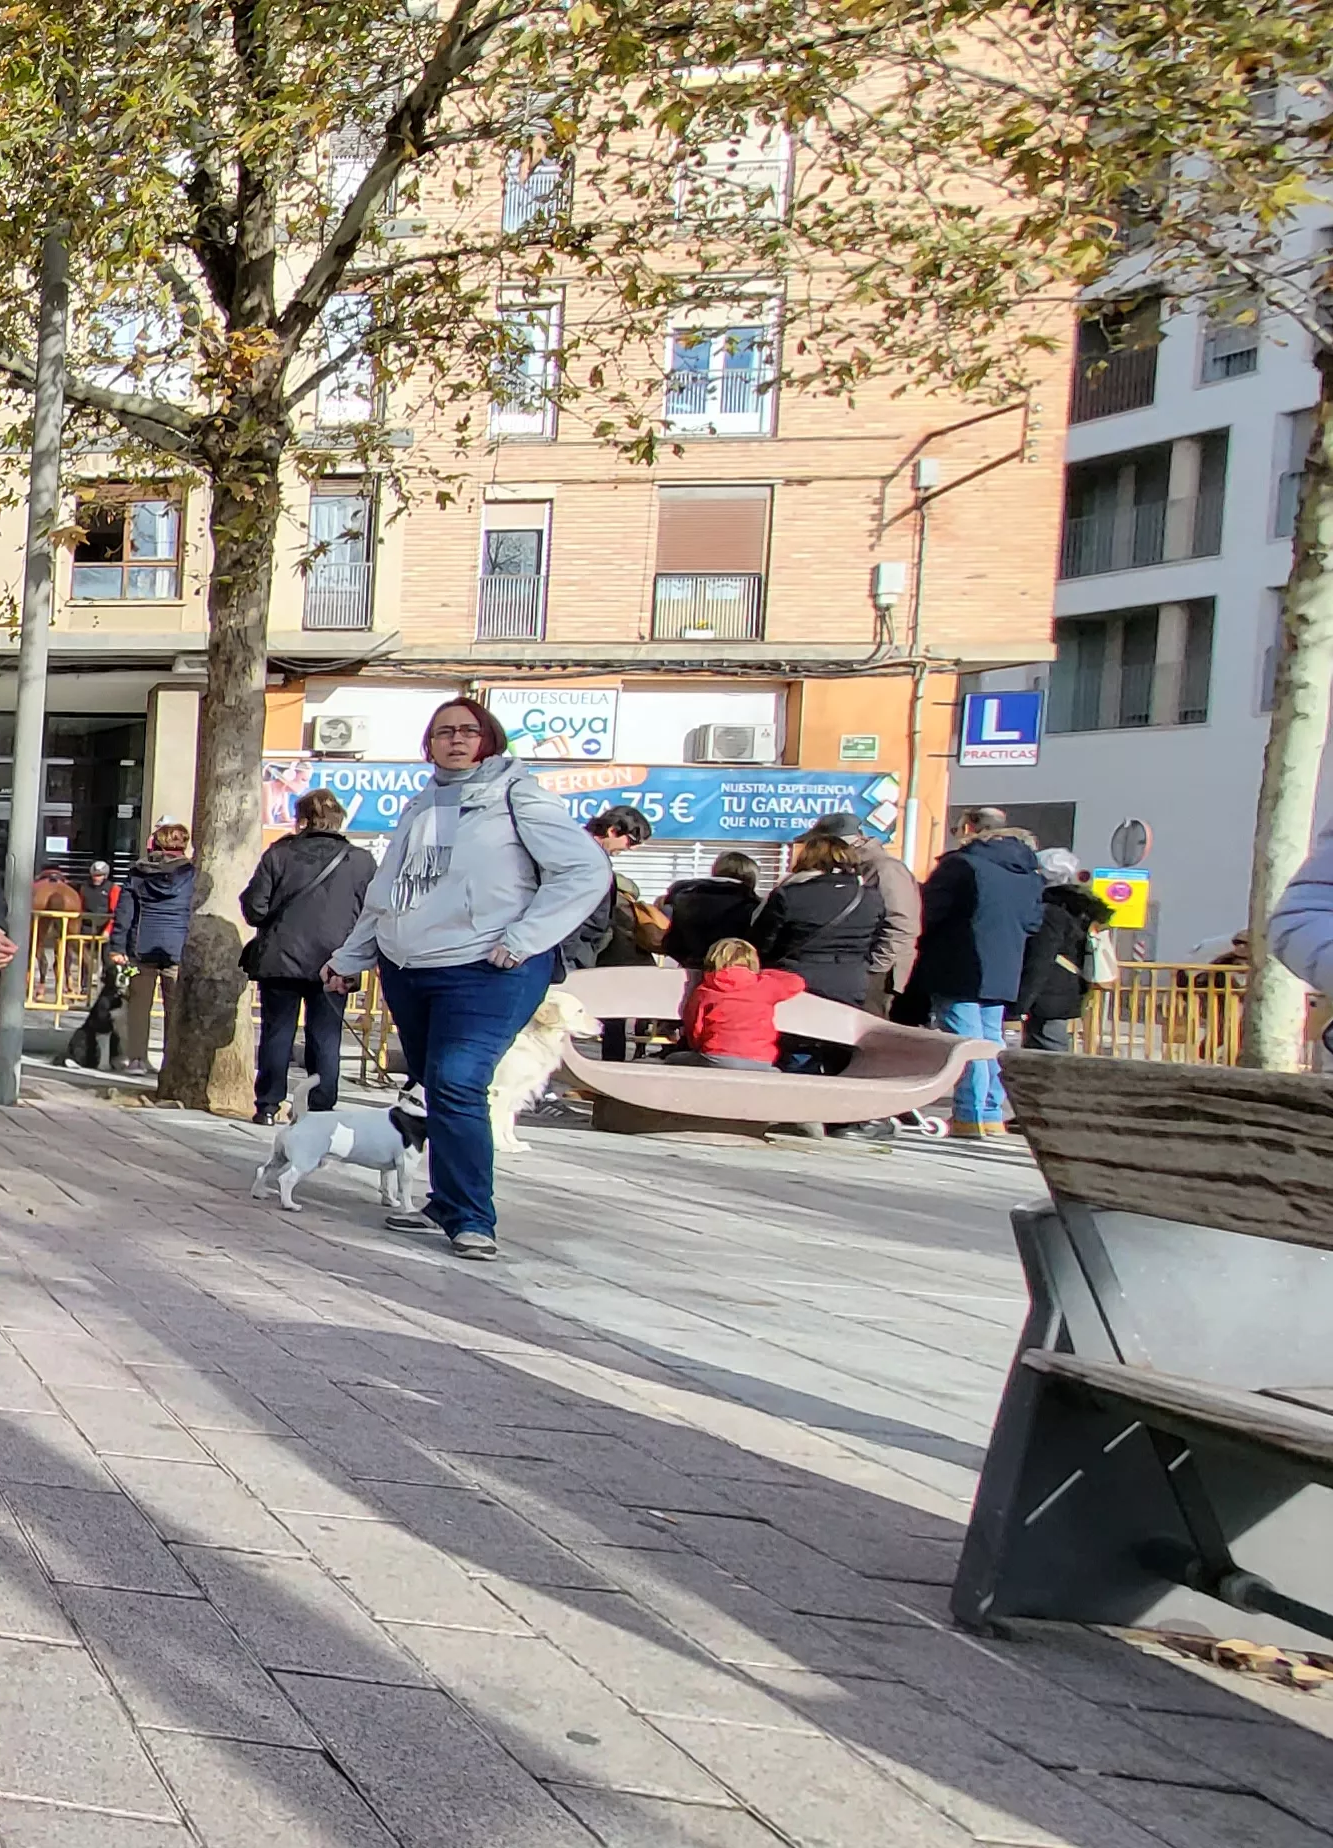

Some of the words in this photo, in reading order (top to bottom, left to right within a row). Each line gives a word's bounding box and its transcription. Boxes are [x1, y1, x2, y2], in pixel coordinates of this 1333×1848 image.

[497, 692, 609, 705] AUTOESCUELA
[523, 708, 608, 738] Goya
[981, 698, 1022, 740] L
[964, 750, 1037, 759] PRACTICAS
[319, 769, 433, 792] FORMAC
[721, 783, 775, 793] NUESTRA
[778, 784, 854, 795] EXPERIENCIA
[720, 797, 746, 813] TU
[752, 795, 854, 814] GARANTÍA
[720, 816, 746, 829] QUE
[750, 817, 770, 828] NO
[774, 817, 789, 828] TE
